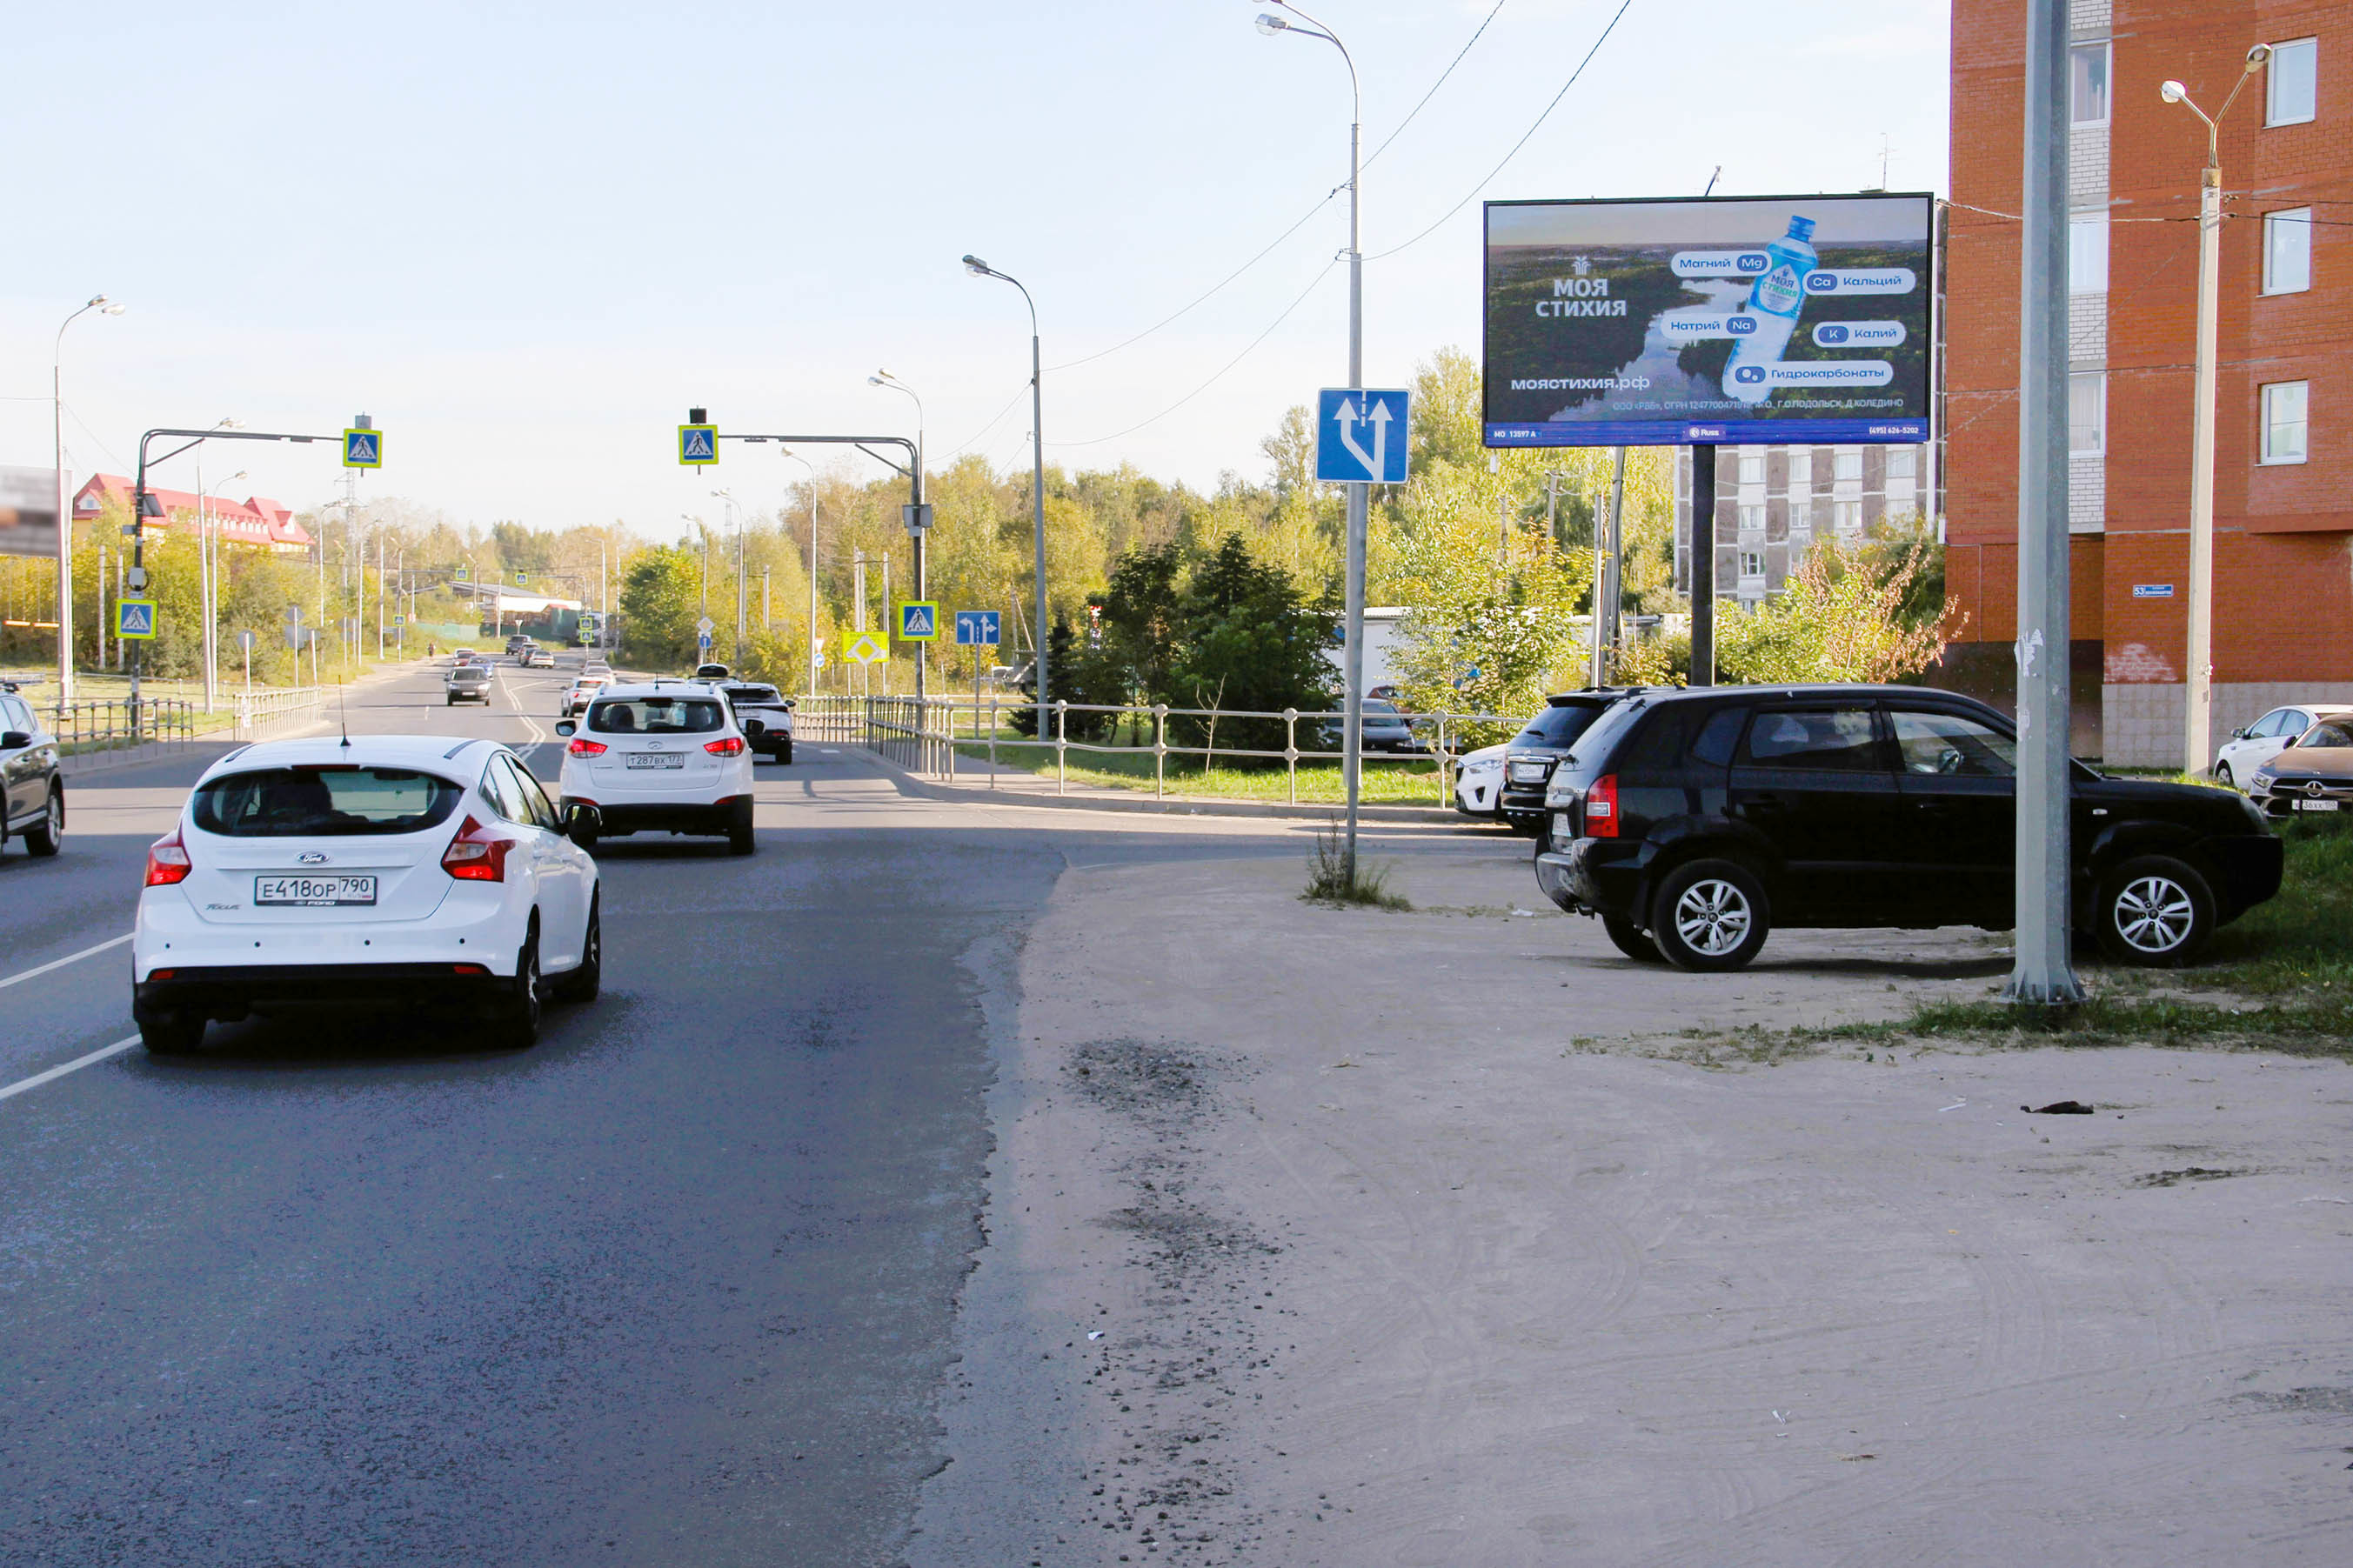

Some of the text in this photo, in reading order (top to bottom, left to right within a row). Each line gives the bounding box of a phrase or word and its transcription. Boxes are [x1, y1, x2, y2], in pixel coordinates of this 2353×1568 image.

[1680, 257, 1731, 268] Магний
[1741, 257, 1762, 270] Mg
[1813, 277, 1831, 287] Ca
[1843, 275, 1902, 286] Кальций
[1554, 278, 1608, 297] МОЯ
[1535, 300, 1628, 317] СТИХИЯ
[1670, 320, 1721, 332] Натрий
[1732, 321, 1751, 330] Na
[1855, 328, 1897, 338] Калий
[1771, 368, 1884, 379] Гидрокарбонаты
[302, 853, 323, 863] Ford
[263, 878, 370, 897] Е418ОР 790
